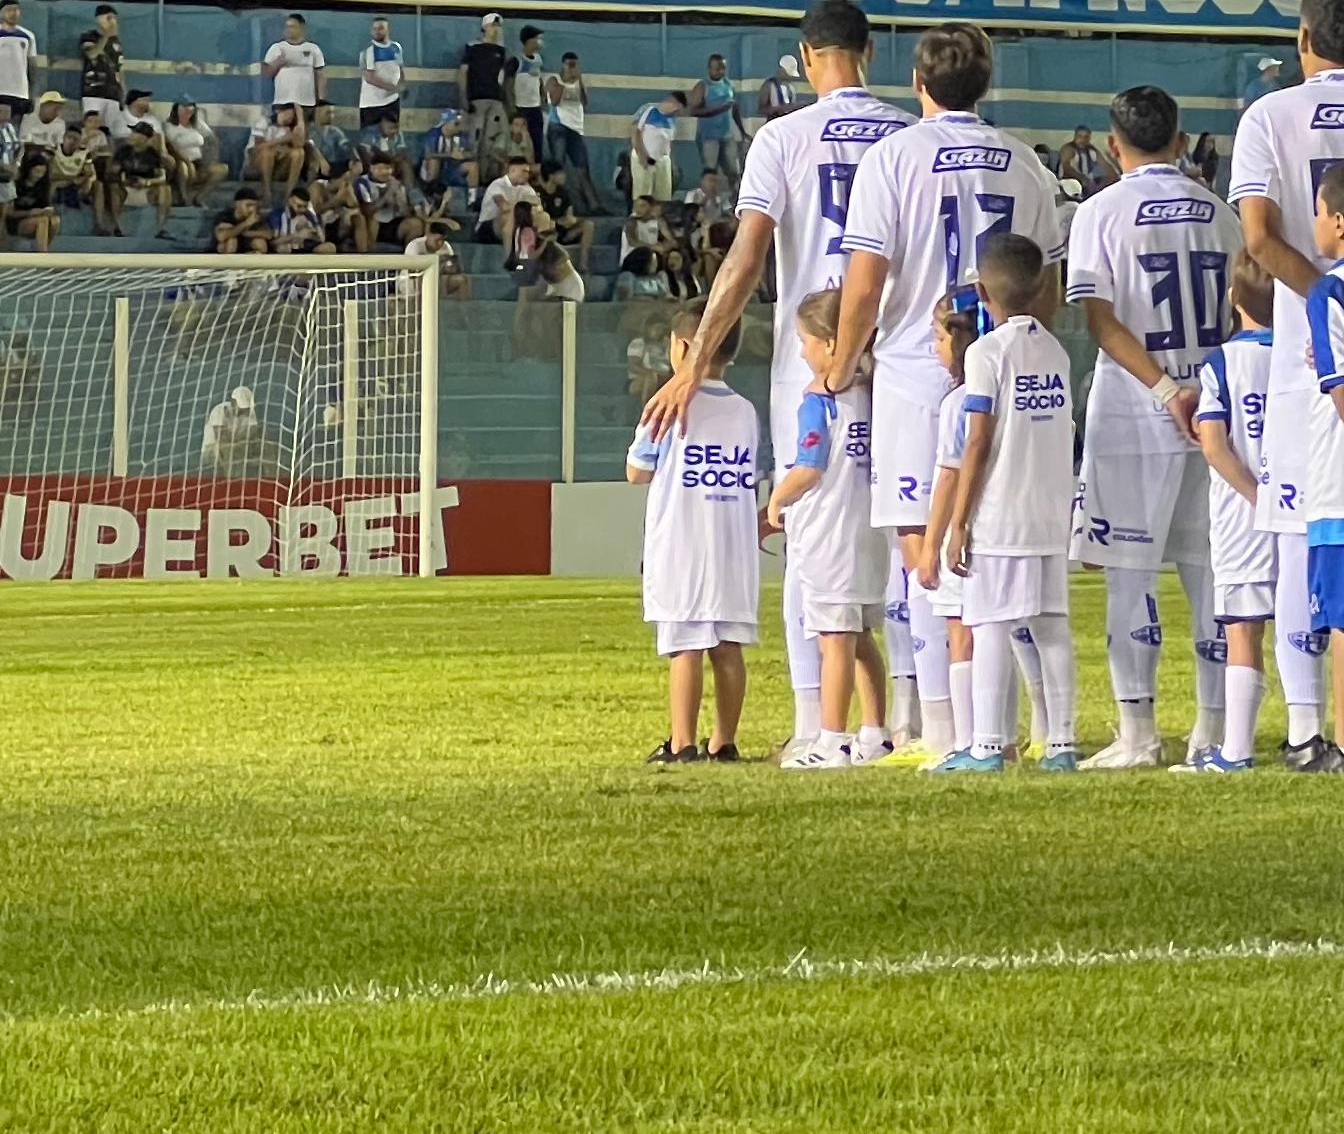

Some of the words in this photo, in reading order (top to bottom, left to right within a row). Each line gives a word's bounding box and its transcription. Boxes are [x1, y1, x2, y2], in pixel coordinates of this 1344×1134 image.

[1136, 250, 1228, 351] 30
[1015, 373, 1064, 392] SEJA
[1015, 393, 1065, 411] SÓCIO
[684, 445, 752, 465] SEJA
